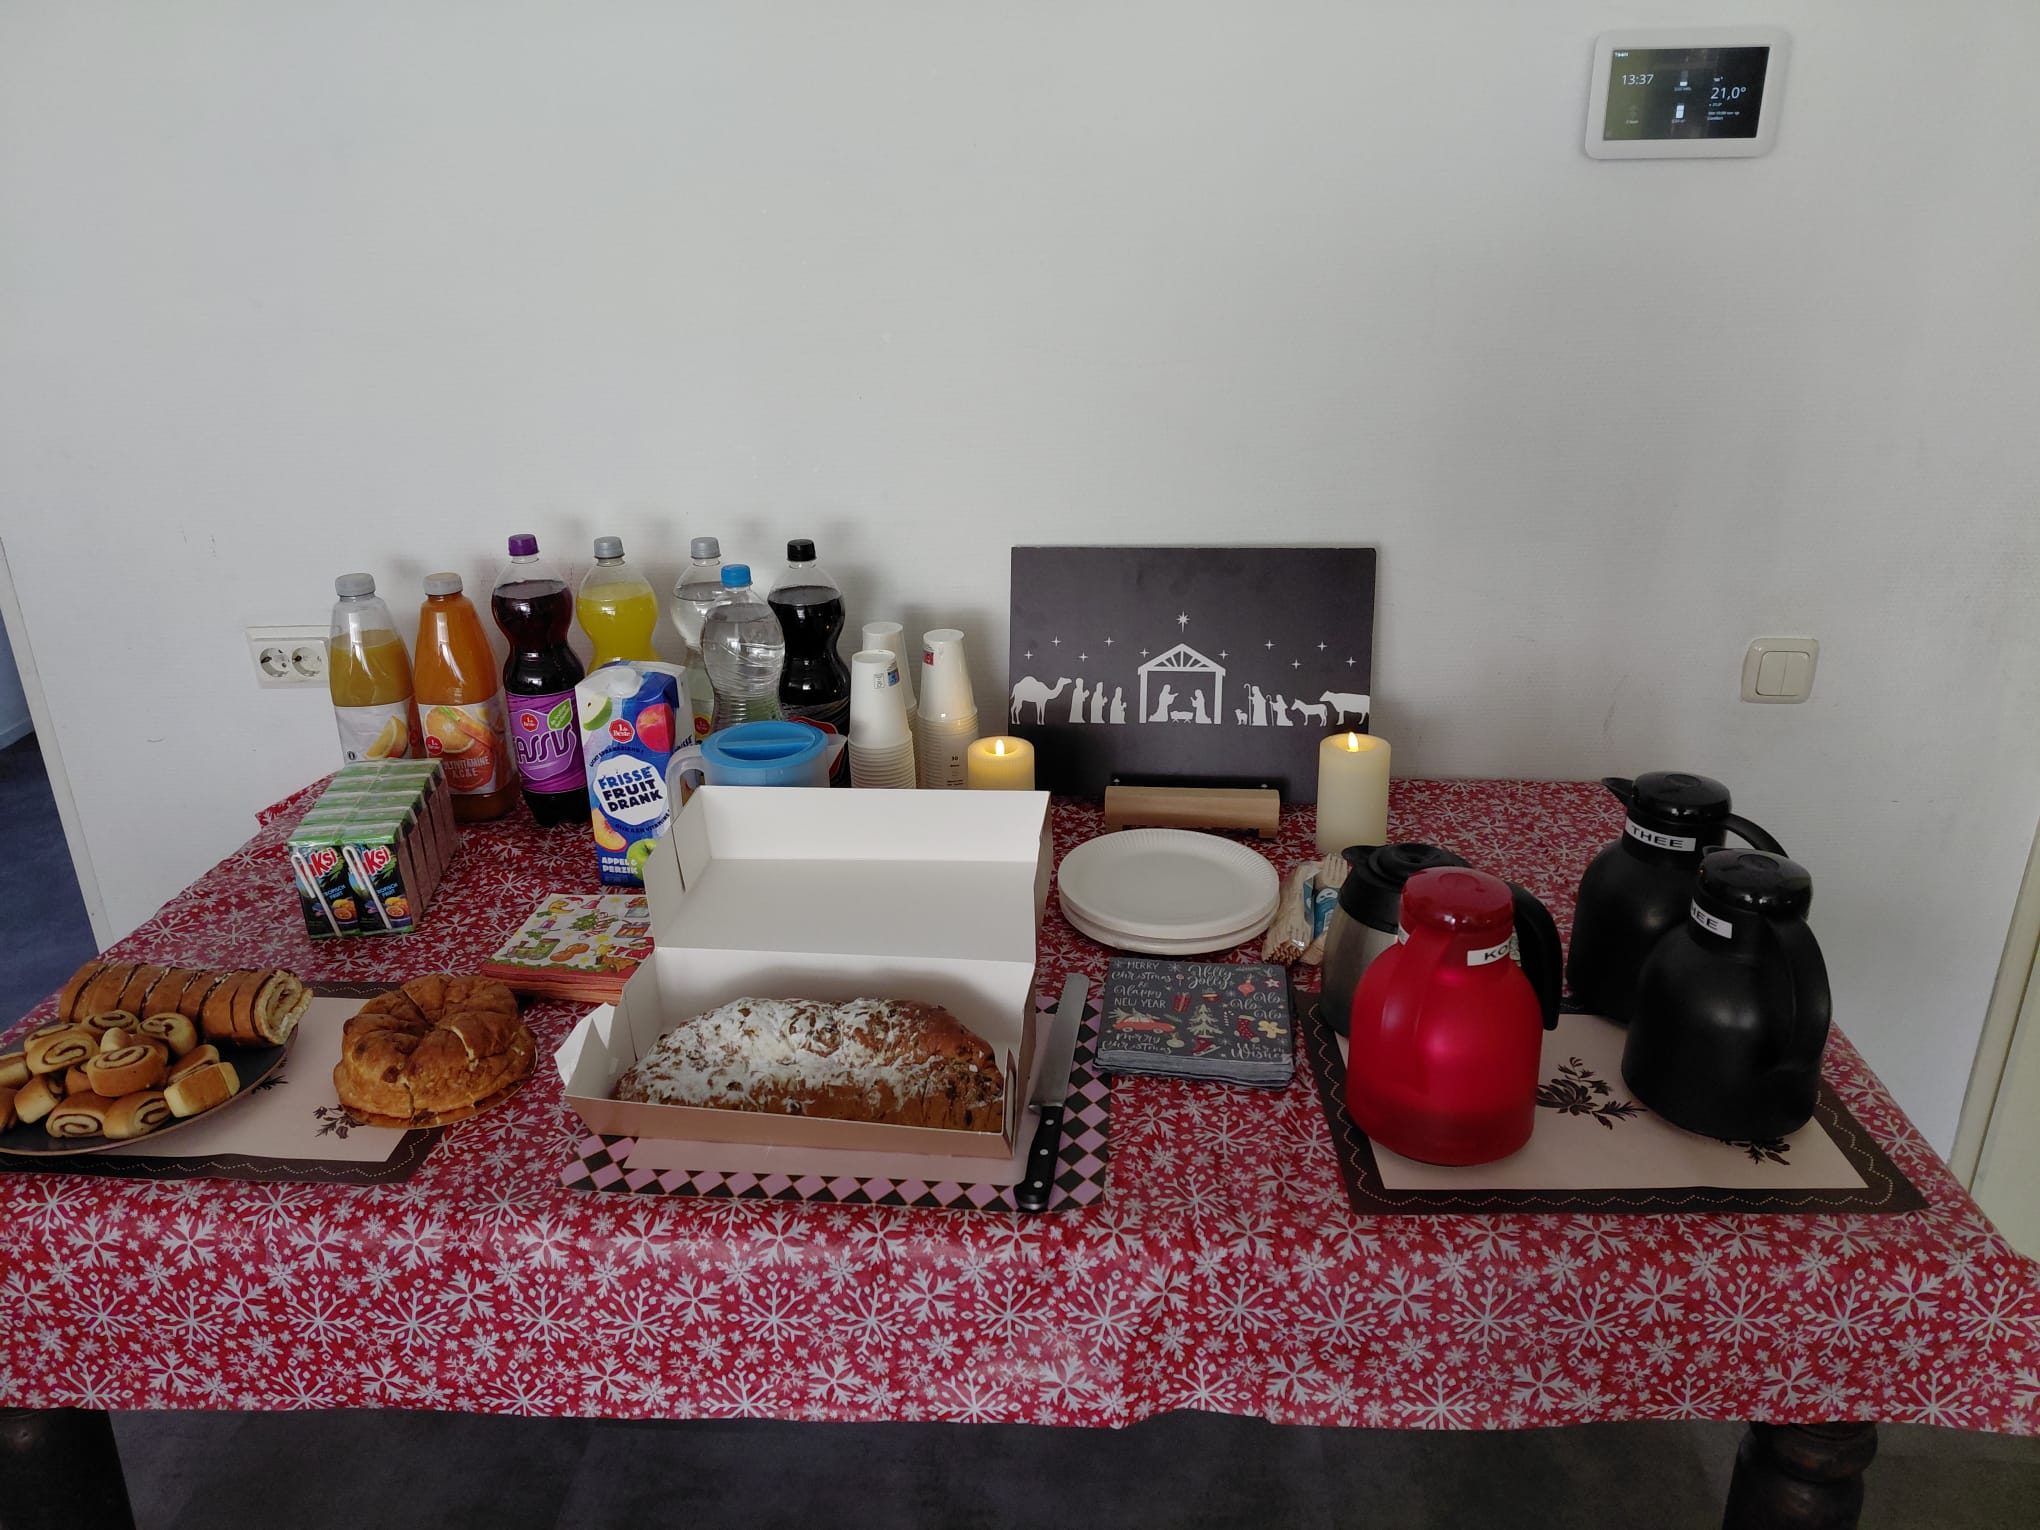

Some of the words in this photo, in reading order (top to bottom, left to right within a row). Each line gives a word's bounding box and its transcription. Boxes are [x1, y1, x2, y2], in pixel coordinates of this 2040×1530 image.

[1622, 73, 1654, 86] 13:37
[513, 723, 572, 764] ASSIS
[597, 766, 654, 790] FRISSE
[602, 778, 656, 802] FRUIT
[607, 789, 664, 813] DRANK
[1631, 824, 1684, 848] THEE
[601, 856, 630, 866] APPEL
[602, 864, 638, 874] PERZIK
[1691, 903, 1719, 931] HEE
[1484, 943, 1511, 961] KO
[1127, 960, 1160, 970] MERRY
[1114, 997, 1138, 1007] NEW
[1140, 998, 1166, 1009] YEAR
